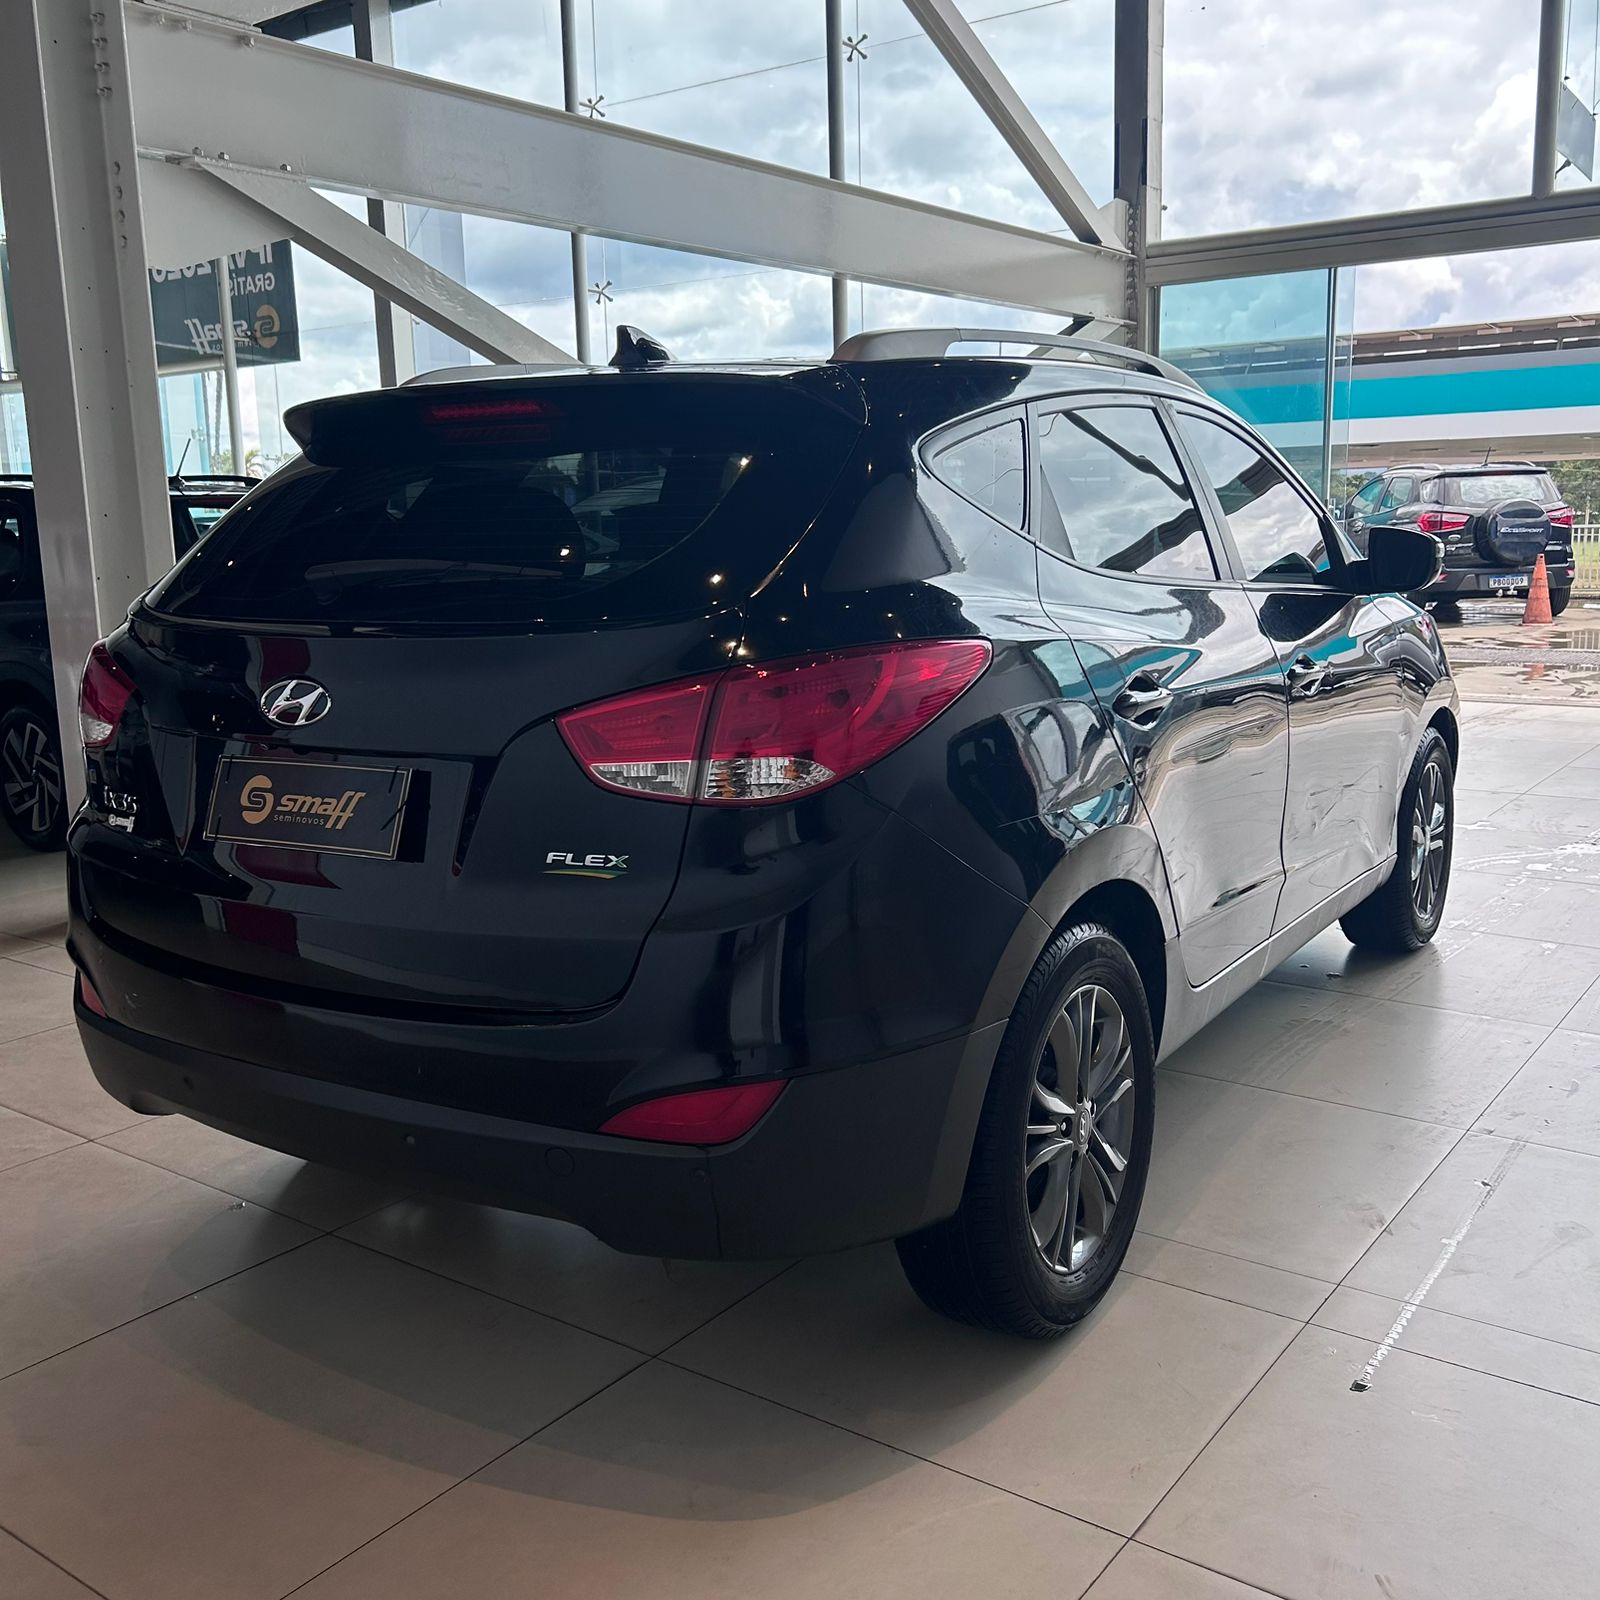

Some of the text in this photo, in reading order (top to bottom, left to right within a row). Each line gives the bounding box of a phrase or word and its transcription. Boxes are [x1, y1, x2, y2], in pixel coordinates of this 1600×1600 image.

[276, 790, 367, 830] smaff
[273, 814, 325, 826] seminovos
[545, 852, 630, 868] FLEX
